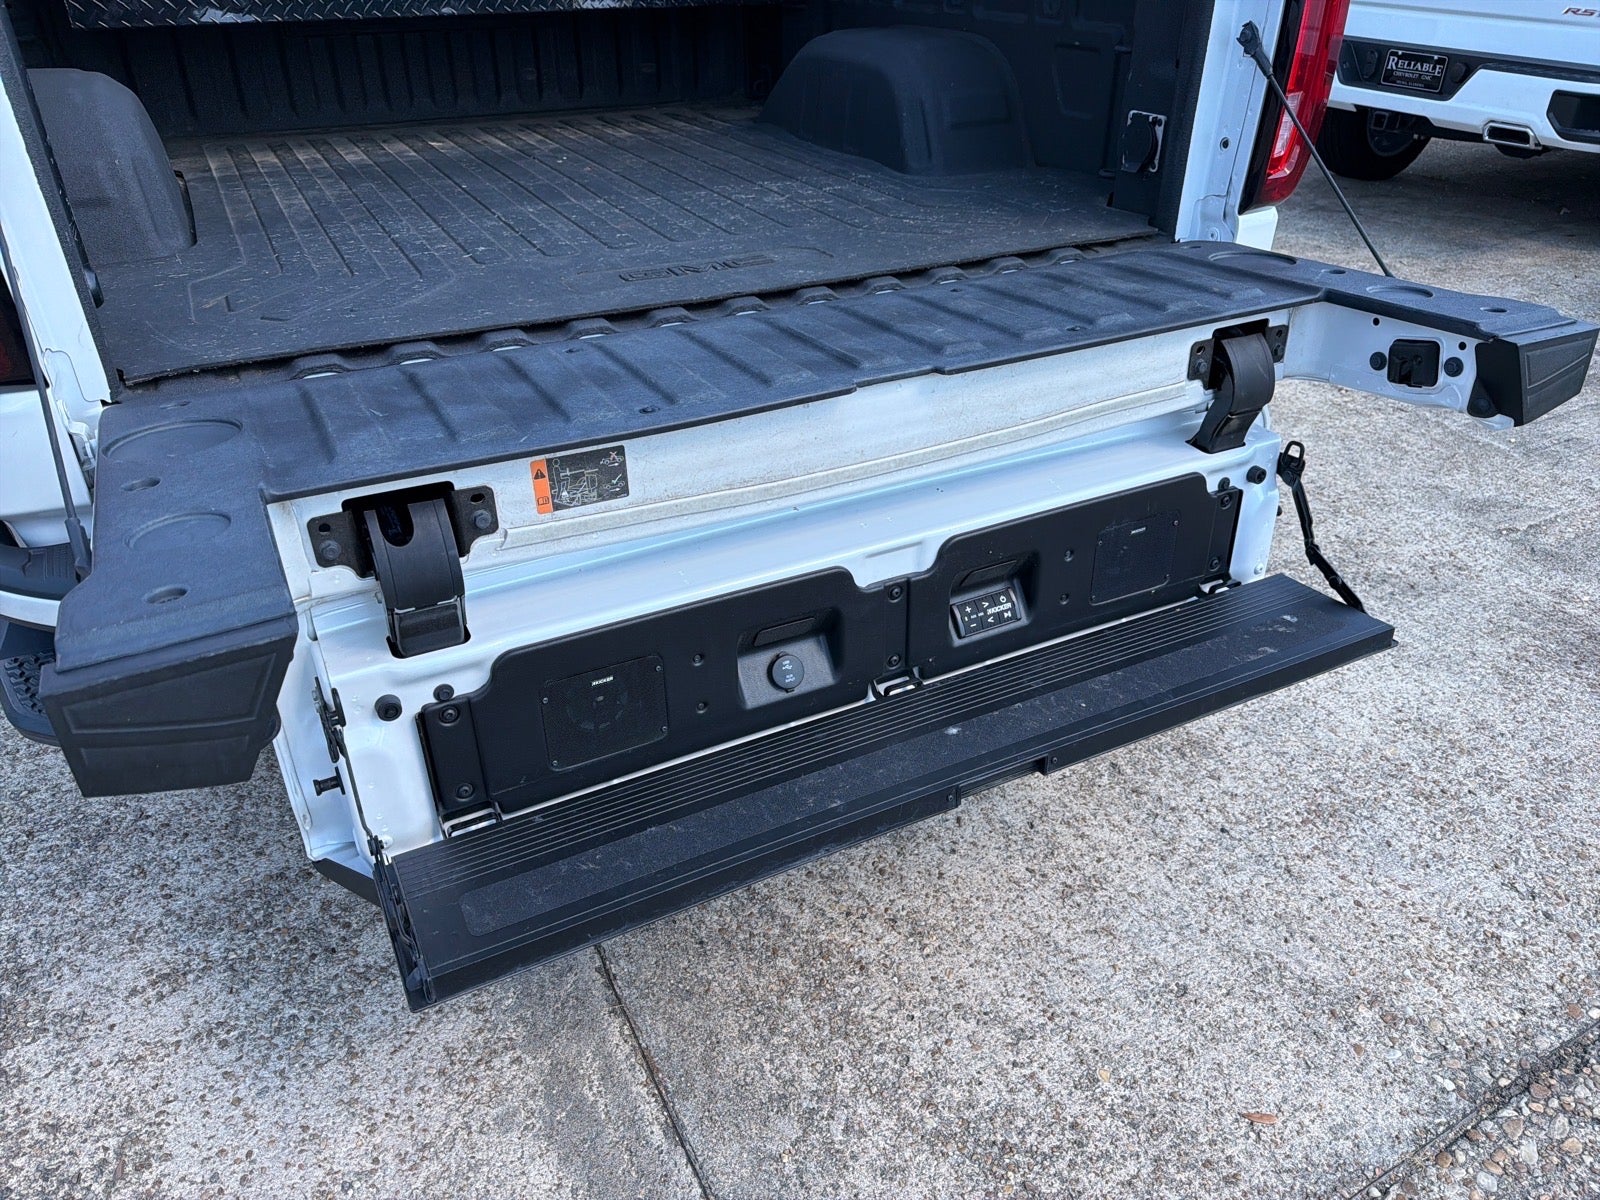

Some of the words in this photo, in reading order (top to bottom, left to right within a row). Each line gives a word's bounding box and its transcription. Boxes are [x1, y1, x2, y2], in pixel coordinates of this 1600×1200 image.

[1562, 7, 1600, 17] RS
[1387, 55, 1444, 76] RELIABLE
[1393, 70, 1419, 80] CHEVROLET
[618, 254, 775, 282] GMC
